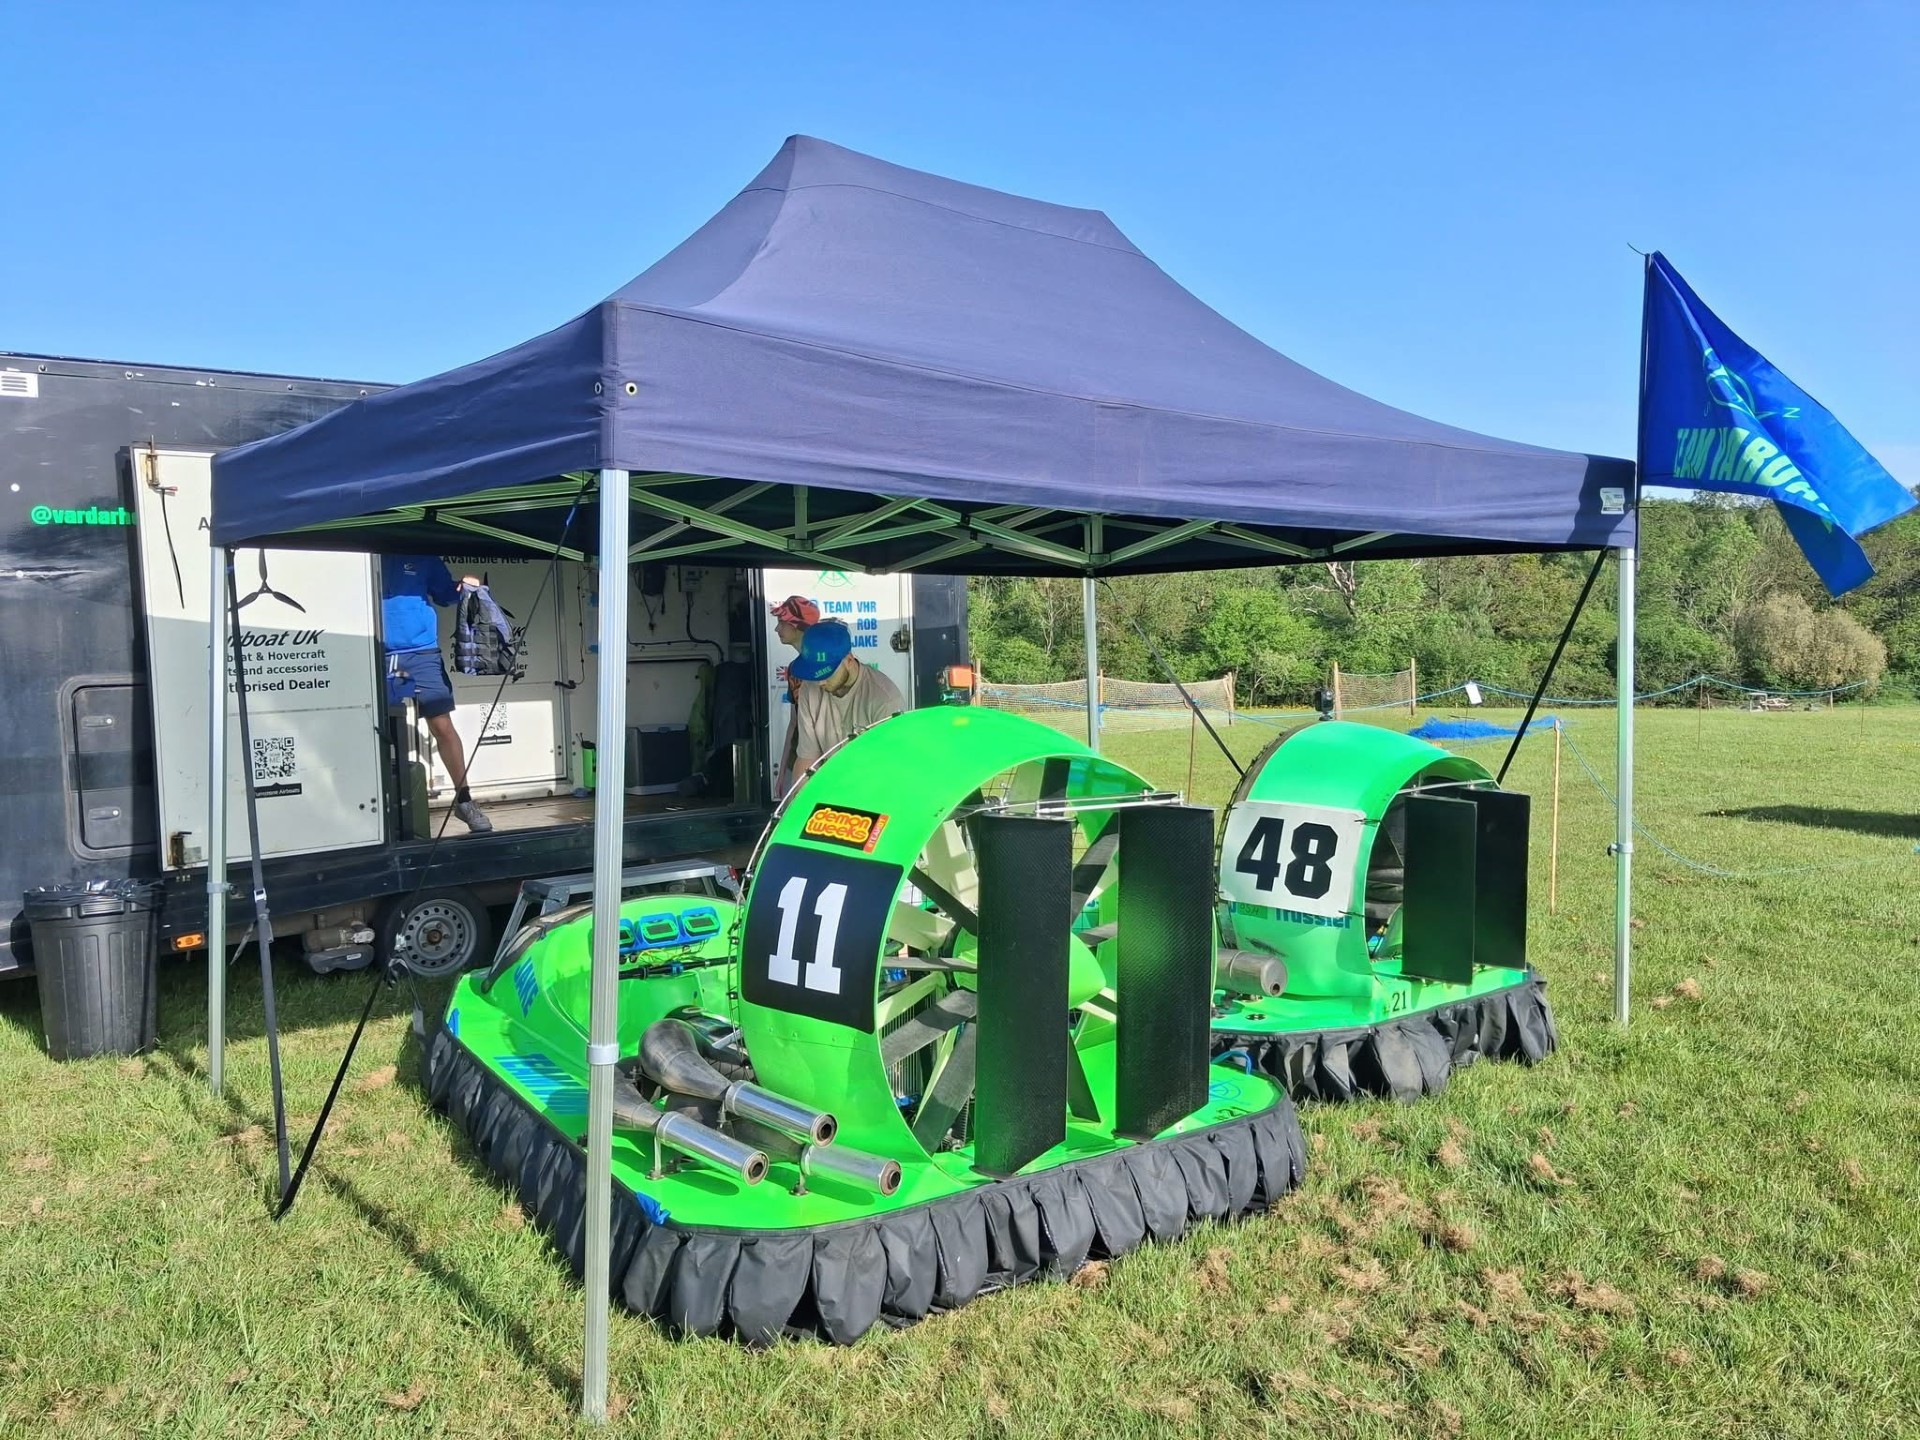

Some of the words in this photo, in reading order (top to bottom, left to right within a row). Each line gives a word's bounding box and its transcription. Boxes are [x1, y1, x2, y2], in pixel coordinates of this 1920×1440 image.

[823, 601, 852, 613] TEAM
[857, 601, 877, 613] VHR
[857, 619, 877, 631] ROB
[292, 629, 325, 645] UK
[851, 635, 878, 648] JAKE
[256, 652, 265, 661] &
[268, 649, 326, 661] Hovercraft
[816, 652, 826, 662] 11
[243, 666, 263, 676] and
[266, 663, 329, 675] accessories
[228, 679, 285, 693] torised
[289, 678, 331, 690] Dealer
[813, 808, 872, 829] demon
[805, 818, 869, 842] tweeks
[1236, 816, 1339, 900] 48
[768, 876, 848, 995] 11
[1392, 990, 1407, 1012] 21
